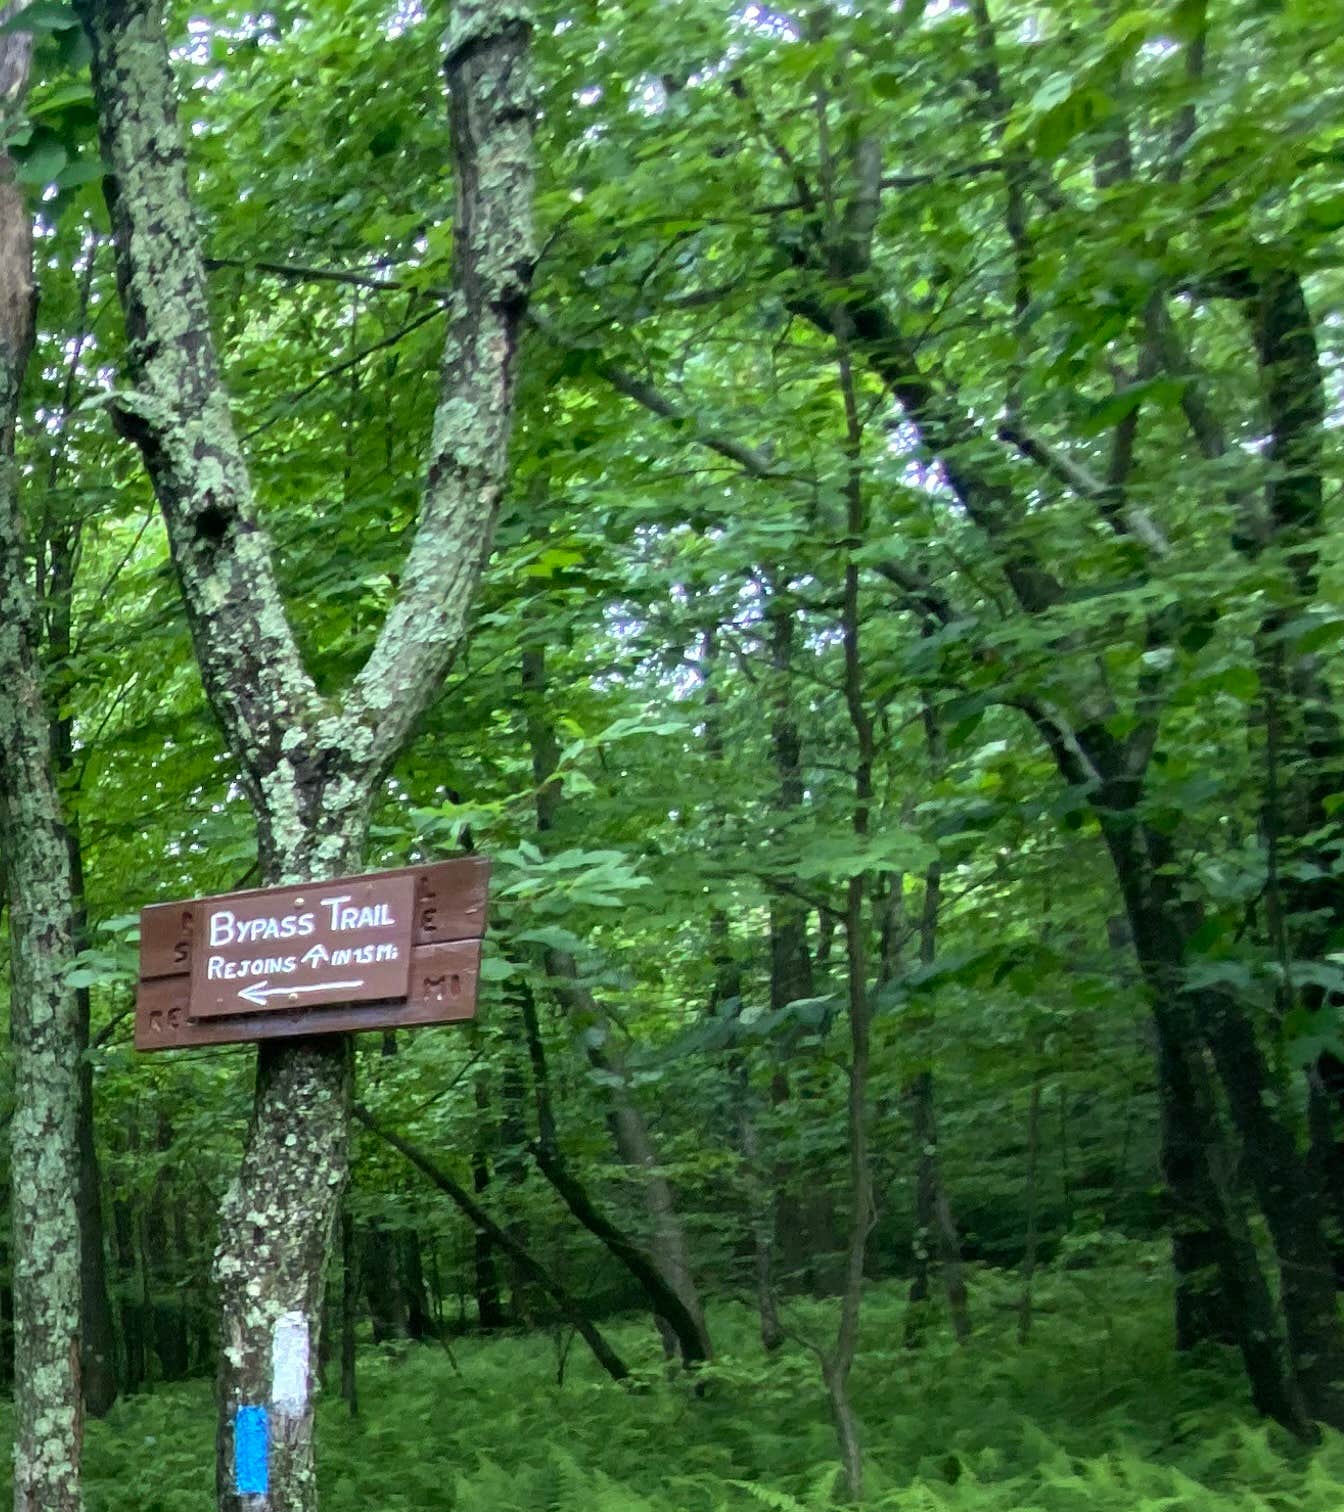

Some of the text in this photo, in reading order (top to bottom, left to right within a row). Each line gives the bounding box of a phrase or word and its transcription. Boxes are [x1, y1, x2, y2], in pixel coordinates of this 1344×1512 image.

[210, 911, 315, 946] BYPASS
[321, 896, 395, 930] TRAIL
[208, 955, 296, 980] REJOINS
